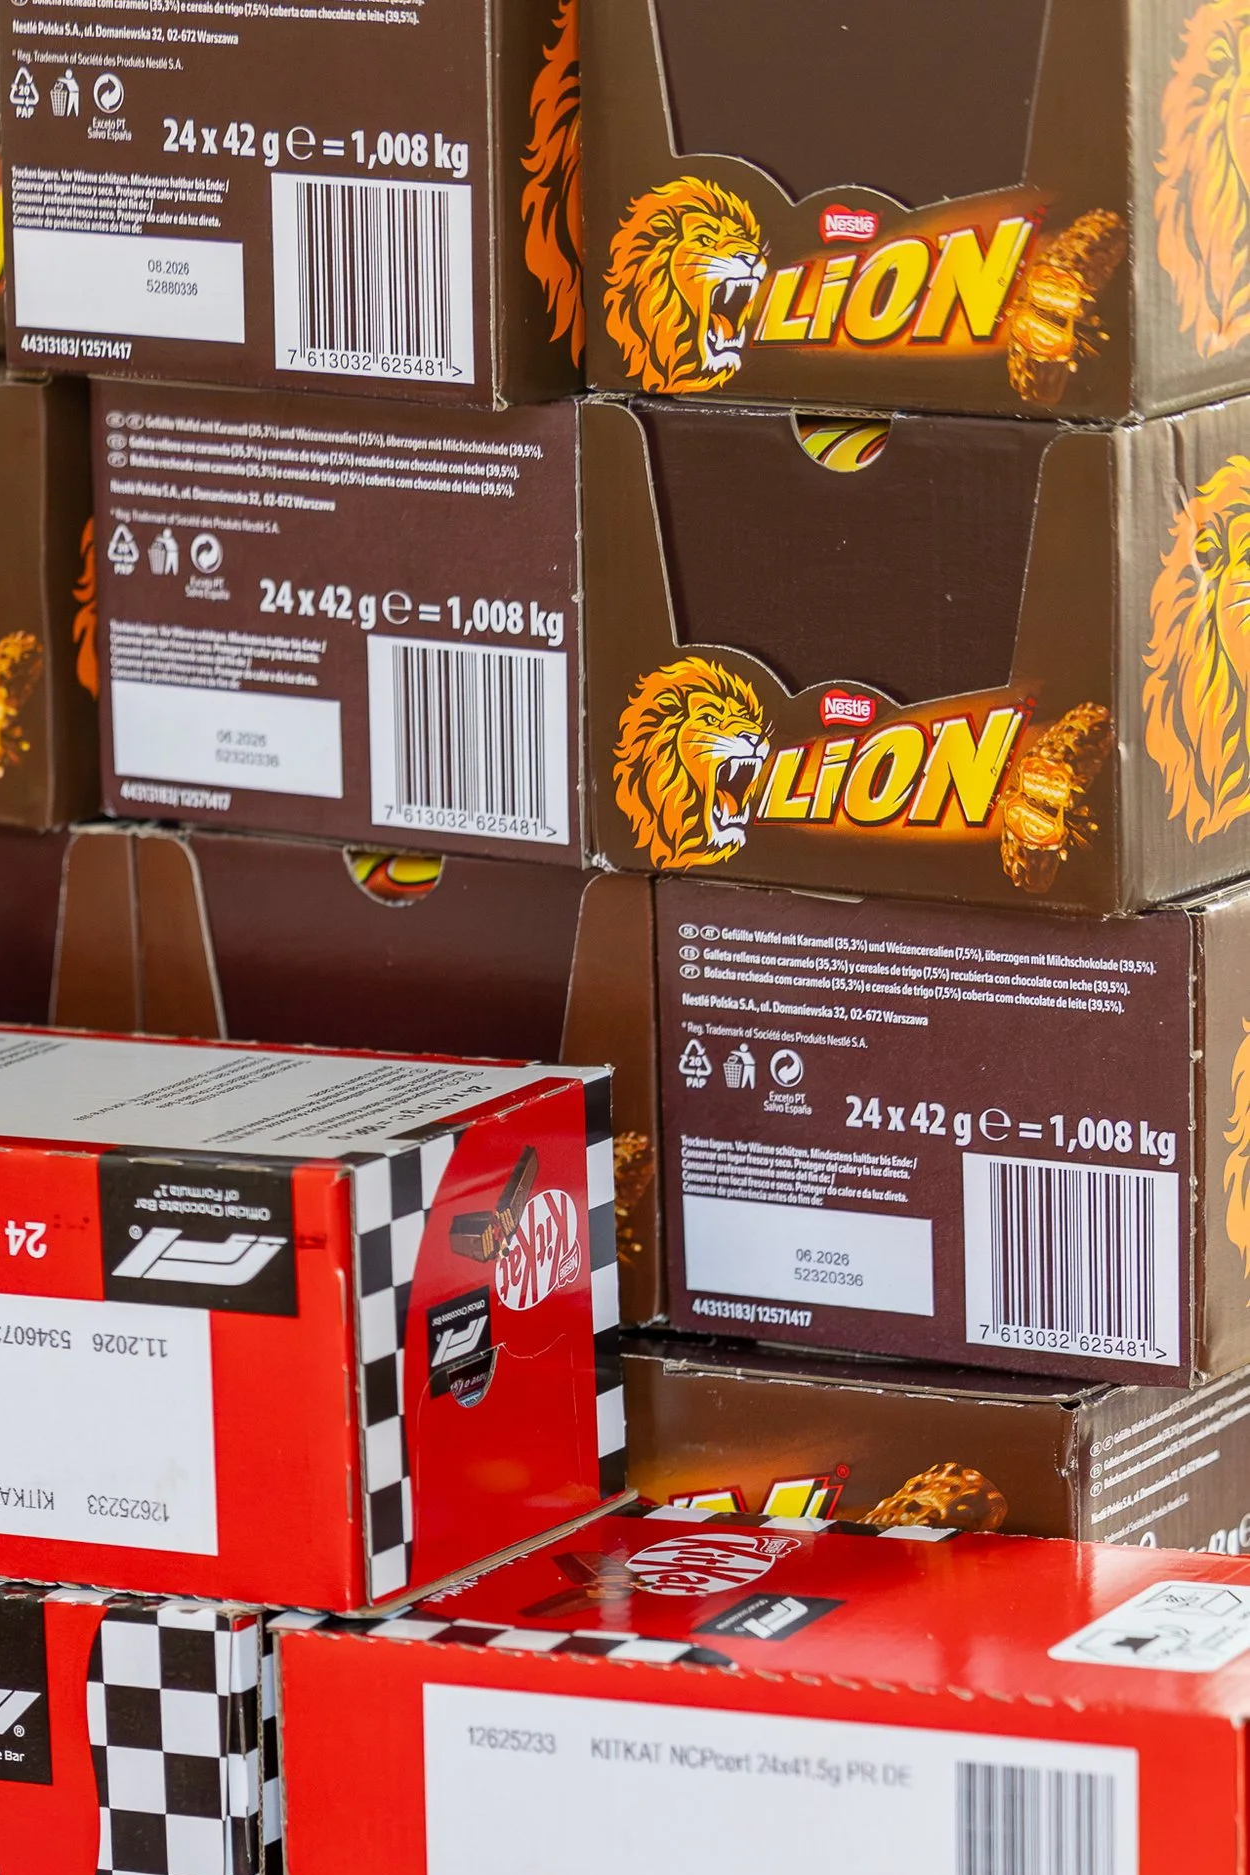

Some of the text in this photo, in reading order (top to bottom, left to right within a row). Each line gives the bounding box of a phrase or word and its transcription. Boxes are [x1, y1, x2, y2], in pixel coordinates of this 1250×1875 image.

[163, 118, 469, 179] 24 x 42 g = 1,008 kg
[147, 260, 190, 276] 08.2026
[146, 279, 198, 296] 52880336
[260, 580, 293, 614] 24
[298, 591, 316, 617] x
[319, 586, 351, 620] 42
[360, 594, 376, 629] g
[418, 603, 441, 623] =
[447, 597, 524, 636] 1,008
[531, 602, 565, 647] kg
[722, 928, 754, 943] Gefüllte
[754, 932, 781, 944] Waffel
[782, 934, 797, 945] mit
[798, 935, 834, 949] Karamell
[834, 938, 868, 952] (35,3%)
[869, 941, 885, 953] und
[886, 942, 954, 959] Weizencerealien
[985, 950, 1030, 966] überzogen
[1031, 954, 1046, 966] mit
[1046, 955, 1118, 971] Milchschokolade
[1119, 959, 1157, 975] (39,5%).
[682, 992, 710, 1007] Nestlé
[710, 996, 739, 1010] Polska
[760, 1001, 772, 1013] ul.
[773, 1002, 833, 1019] Domaniewska
[833, 1007, 848, 1021] 32,
[850, 1008, 882, 1022] 02-672
[883, 1009, 928, 1026] Warszawa
[846, 1096, 1176, 1166] 24 x 42 g = 1,008 kg
[134, 1198, 158, 1211] Bar
[227, 1190, 239, 1201] of
[158, 1199, 223, 1217] Chocolate
[5, 1222, 47, 1259] 24
[796, 1248, 850, 1267] 06.2026
[794, 1266, 864, 1288] 52320336
[92, 1334, 168, 1357] 11.2026
[1000, 1326, 1070, 1350] 613032
[87, 1494, 170, 1522] 12625233
[4, 1748, 25, 1763] Bar
[467, 1725, 557, 1755] 12625233
[591, 1737, 662, 1764] KITKAT
[669, 1745, 752, 1774] NCPcert
[847, 1763, 874, 1785] PR
[882, 1766, 913, 1786] DE
